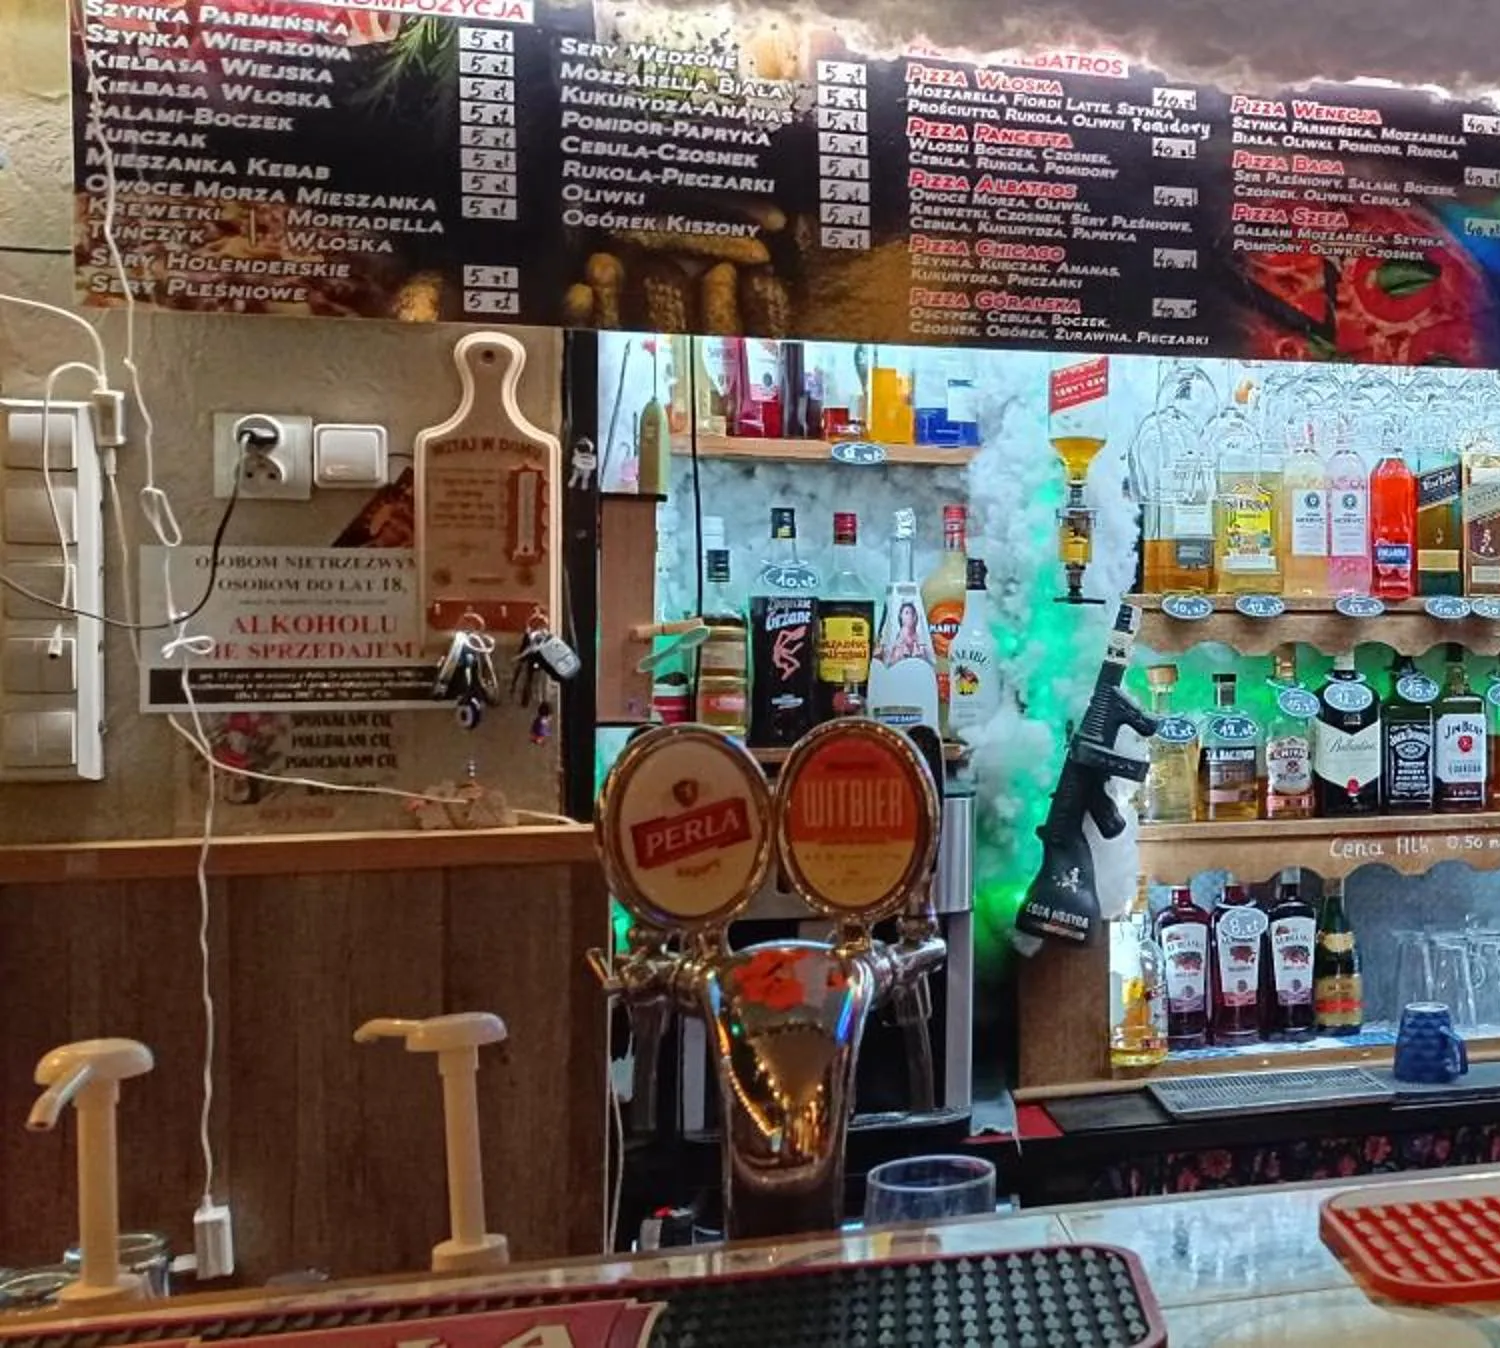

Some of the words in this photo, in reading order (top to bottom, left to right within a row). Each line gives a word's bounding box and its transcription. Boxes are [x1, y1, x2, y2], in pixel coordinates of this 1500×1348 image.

[86, 24, 189, 48] SZYNKA
[202, 31, 351, 61] WIEPRZOWA
[560, 37, 618, 59] SERY
[221, 57, 333, 83] WIEJSKA
[560, 62, 708, 93] MOZZARELLA
[907, 63, 968, 86] PIZZA
[908, 86, 1008, 106] MOZZARELLA
[1231, 96, 1287, 118] PIZZA
[1292, 101, 1382, 125] WENECJA
[561, 111, 771, 147] POMIDOR-PAPRYKA
[907, 117, 968, 140] PIZZA
[974, 122, 1074, 149] PANCETTA
[561, 135, 759, 168] CEBULA-CZOSNEK
[1232, 150, 1288, 172] PIZZA
[247, 159, 331, 180] KEBAB
[562, 160, 775, 193] RUKOLA-PIECZARKI
[562, 184, 645, 206] OLIWKI
[908, 168, 969, 192] PIZZA
[975, 174, 1078, 199] ALBATROS
[193, 181, 286, 204] MORZA
[297, 187, 436, 213] MIESZANKA
[287, 212, 444, 234] MORTADELLA
[1233, 203, 1288, 224] PIZZA
[666, 216, 761, 238] KISZONY
[909, 234, 970, 258] PIZZA
[167, 252, 351, 278] HOLENDERSKIE
[306, 578, 333, 592] DO
[230, 614, 398, 635] ALKOHOLU
[804, 779, 903, 829] WITBIER
[1330, 838, 1384, 859] Cena
